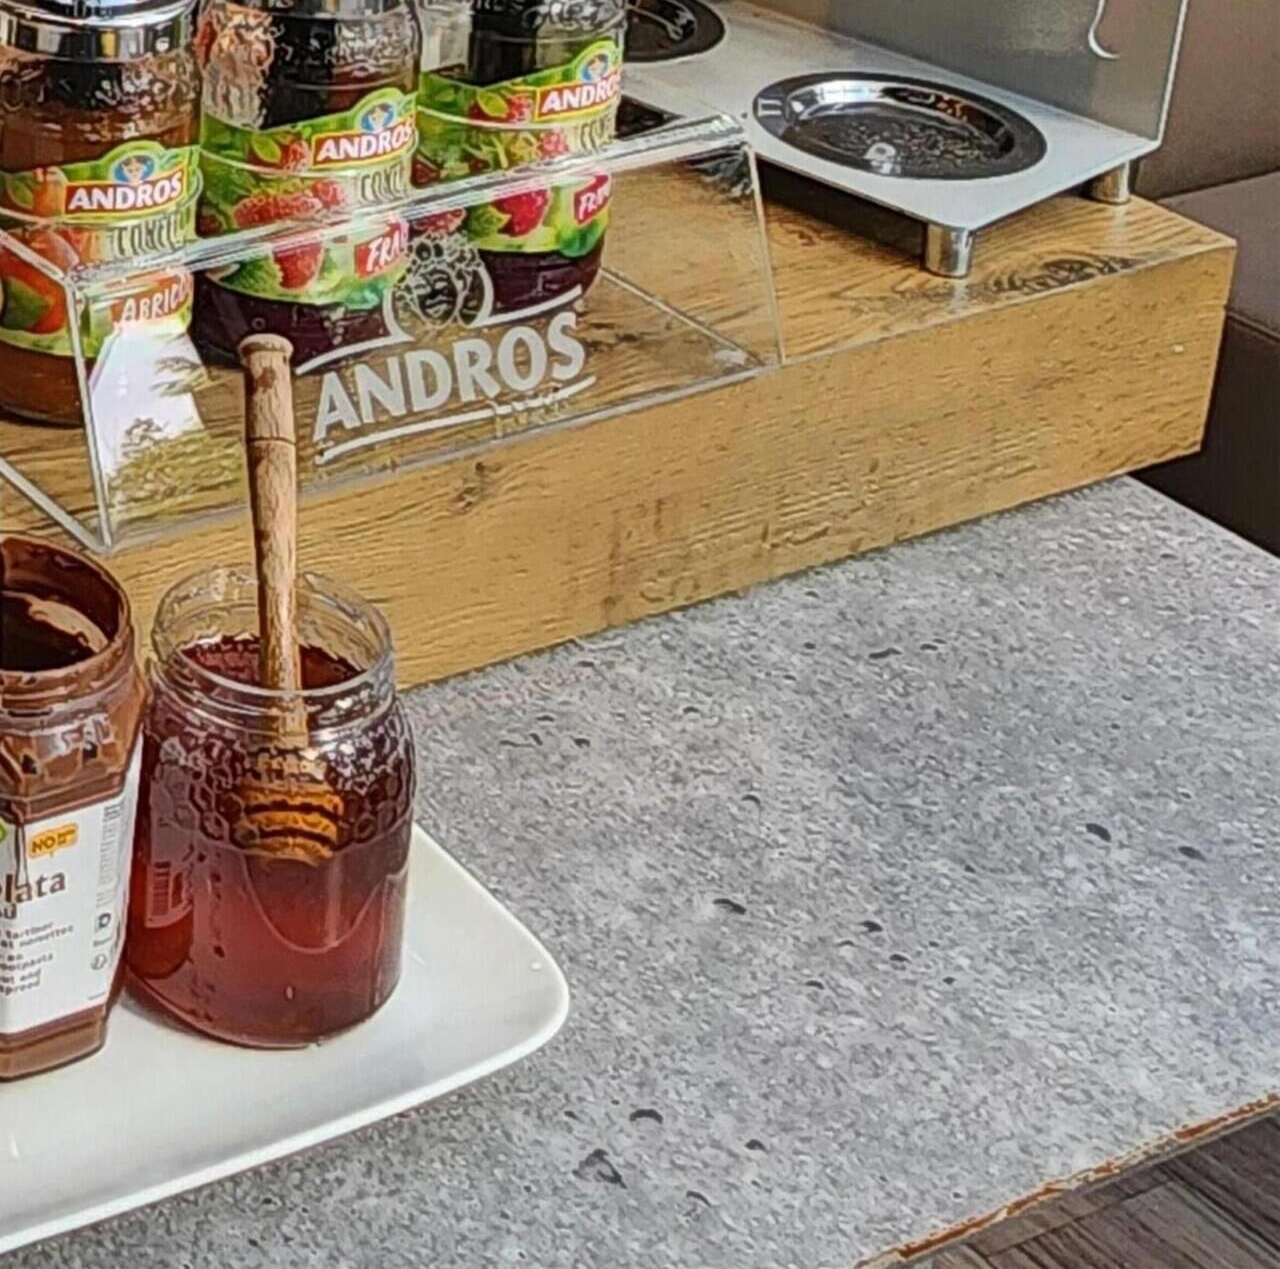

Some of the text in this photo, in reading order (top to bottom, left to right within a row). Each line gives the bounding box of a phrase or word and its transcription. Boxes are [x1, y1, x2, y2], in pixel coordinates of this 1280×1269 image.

[316, 120, 414, 162] ANDROS
[67, 170, 182, 211] ANDROS
[312, 310, 586, 443] ANDROS
